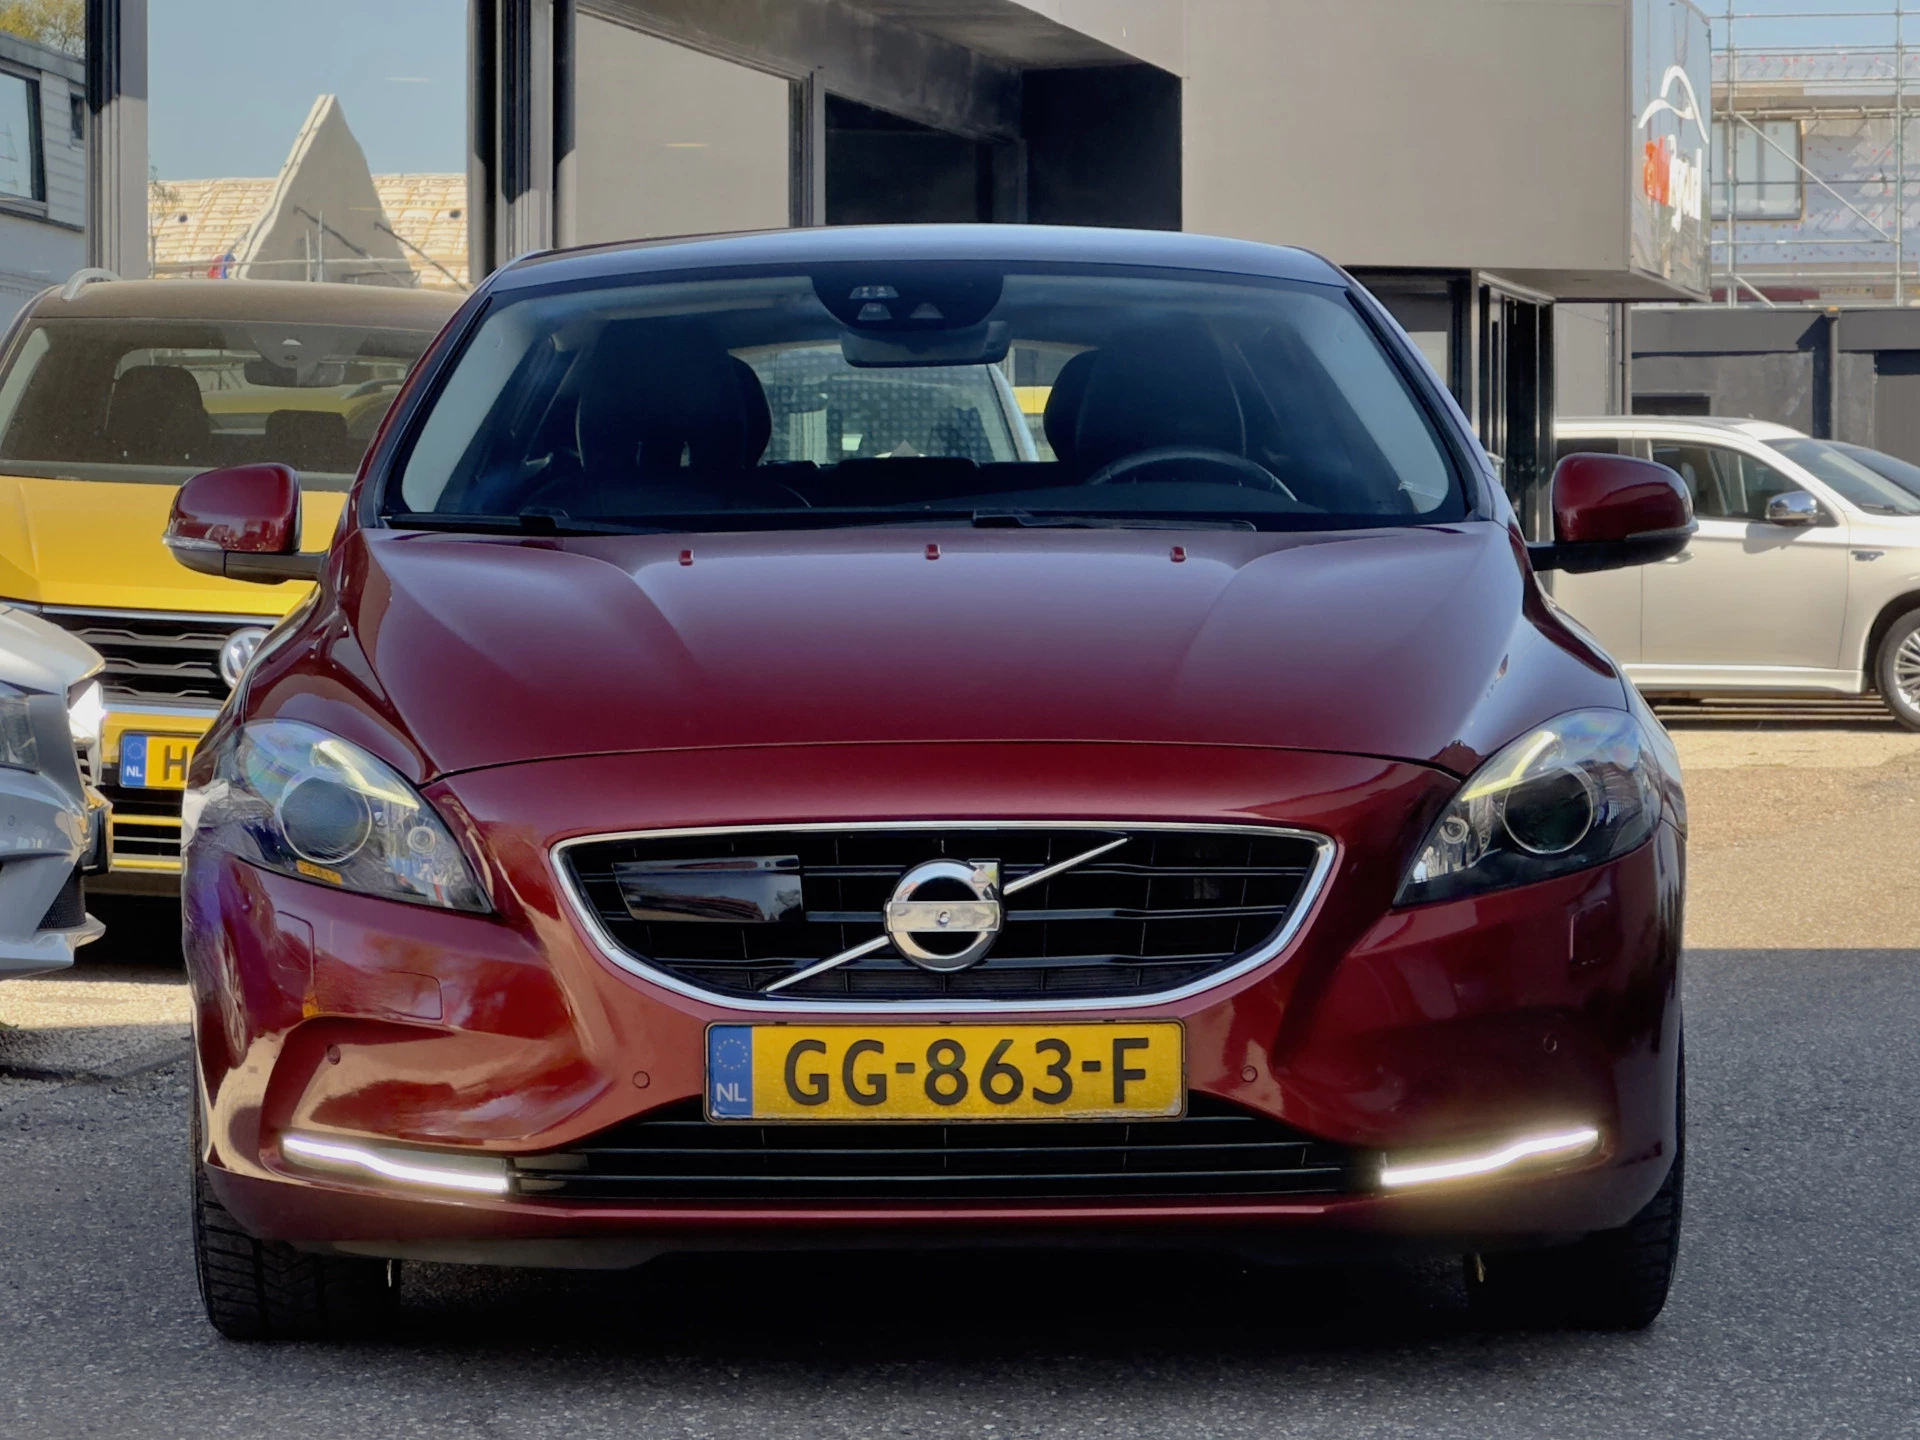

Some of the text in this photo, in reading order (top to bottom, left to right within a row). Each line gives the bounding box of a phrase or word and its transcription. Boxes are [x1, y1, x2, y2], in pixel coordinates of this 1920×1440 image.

[126, 766, 143, 777] NL
[784, 1038, 1150, 1106] GG-863-F
[716, 1082, 748, 1103] NL
